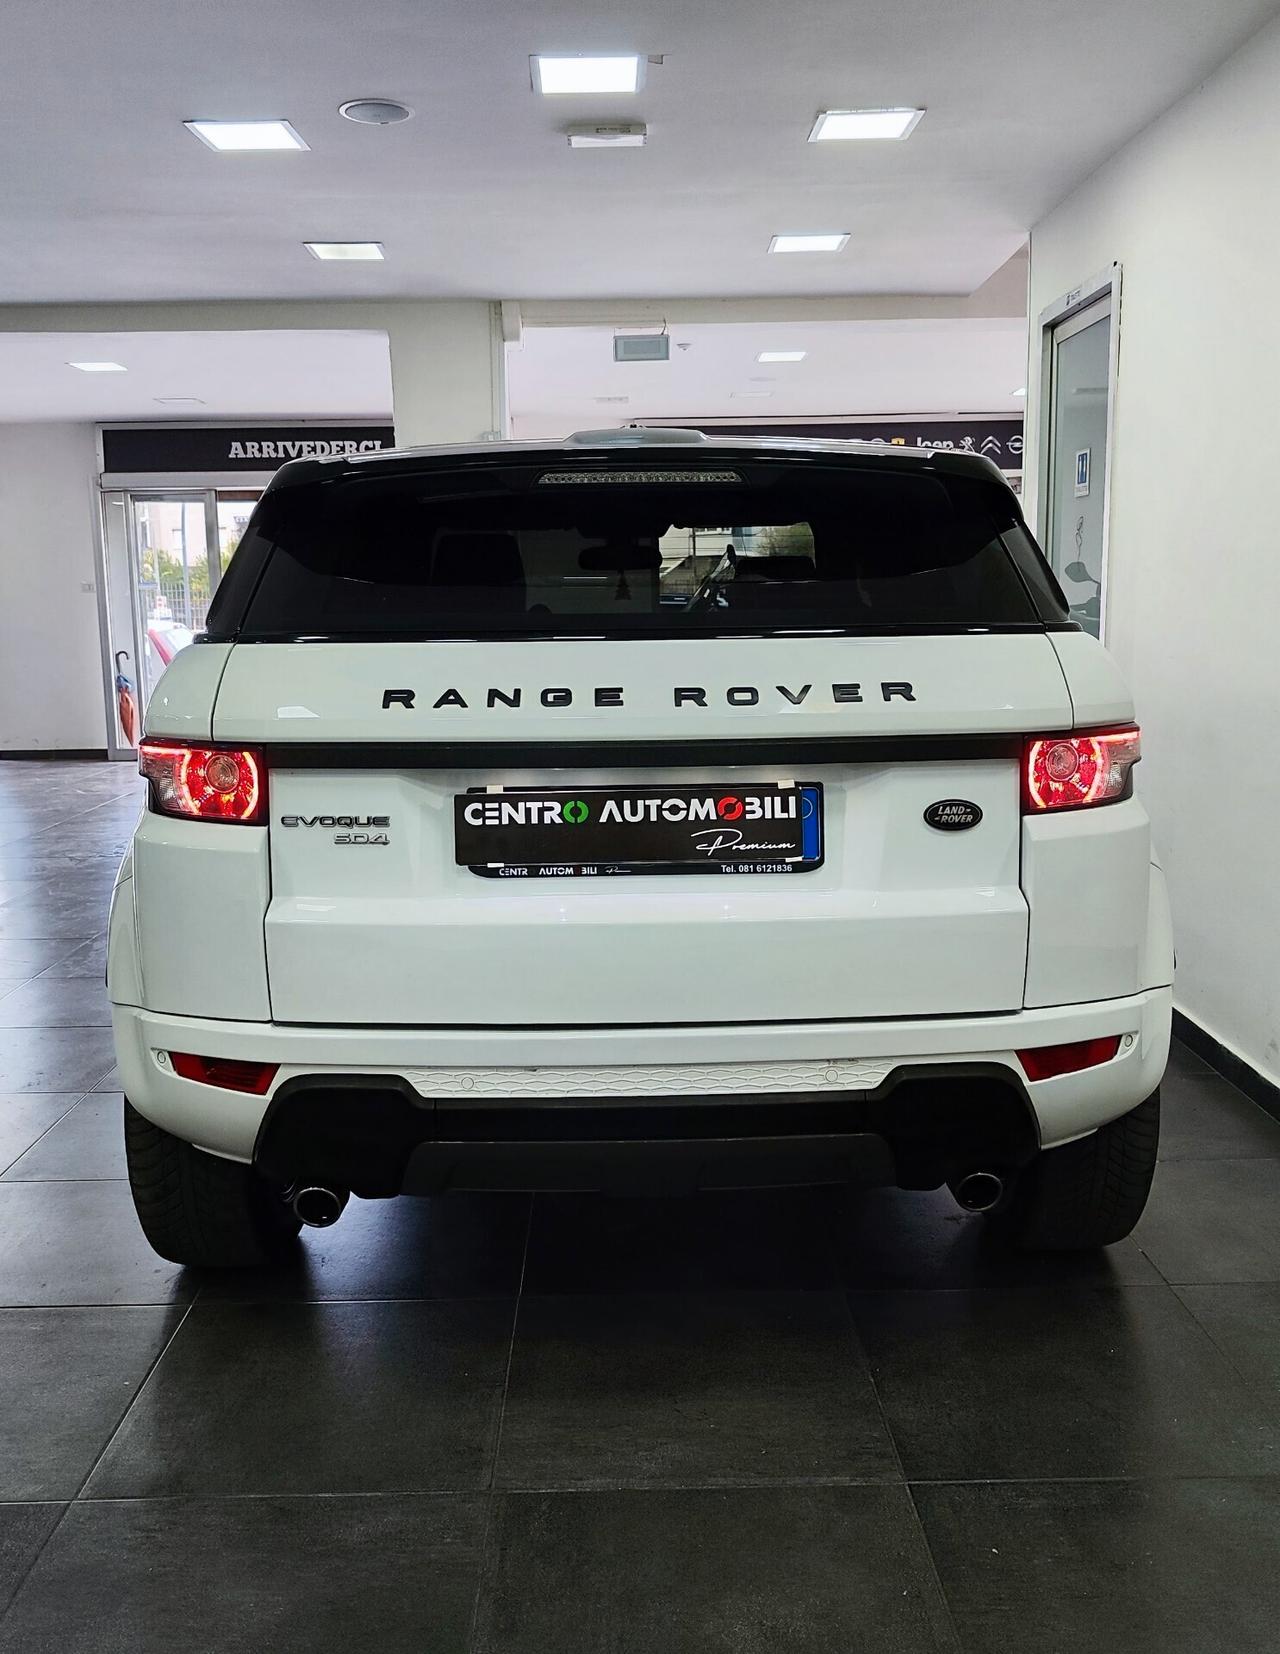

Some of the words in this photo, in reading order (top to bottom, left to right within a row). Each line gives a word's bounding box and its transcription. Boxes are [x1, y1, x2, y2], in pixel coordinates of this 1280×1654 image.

[228, 440, 382, 458] ARRIVEDERCI
[381, 687, 625, 709] RANGE
[673, 681, 917, 707] ROVER
[463, 801, 589, 826] CENTRO
[599, 796, 797, 823] AUTOMOBILI
[281, 816, 390, 828] EVOQUE
[334, 832, 390, 845] SD4
[690, 828, 796, 856] Premium
[499, 867, 535, 877] CENTR
[721, 865, 737, 873] Tel.
[738, 865, 754, 873] 081
[756, 864, 793, 873] 6121836
